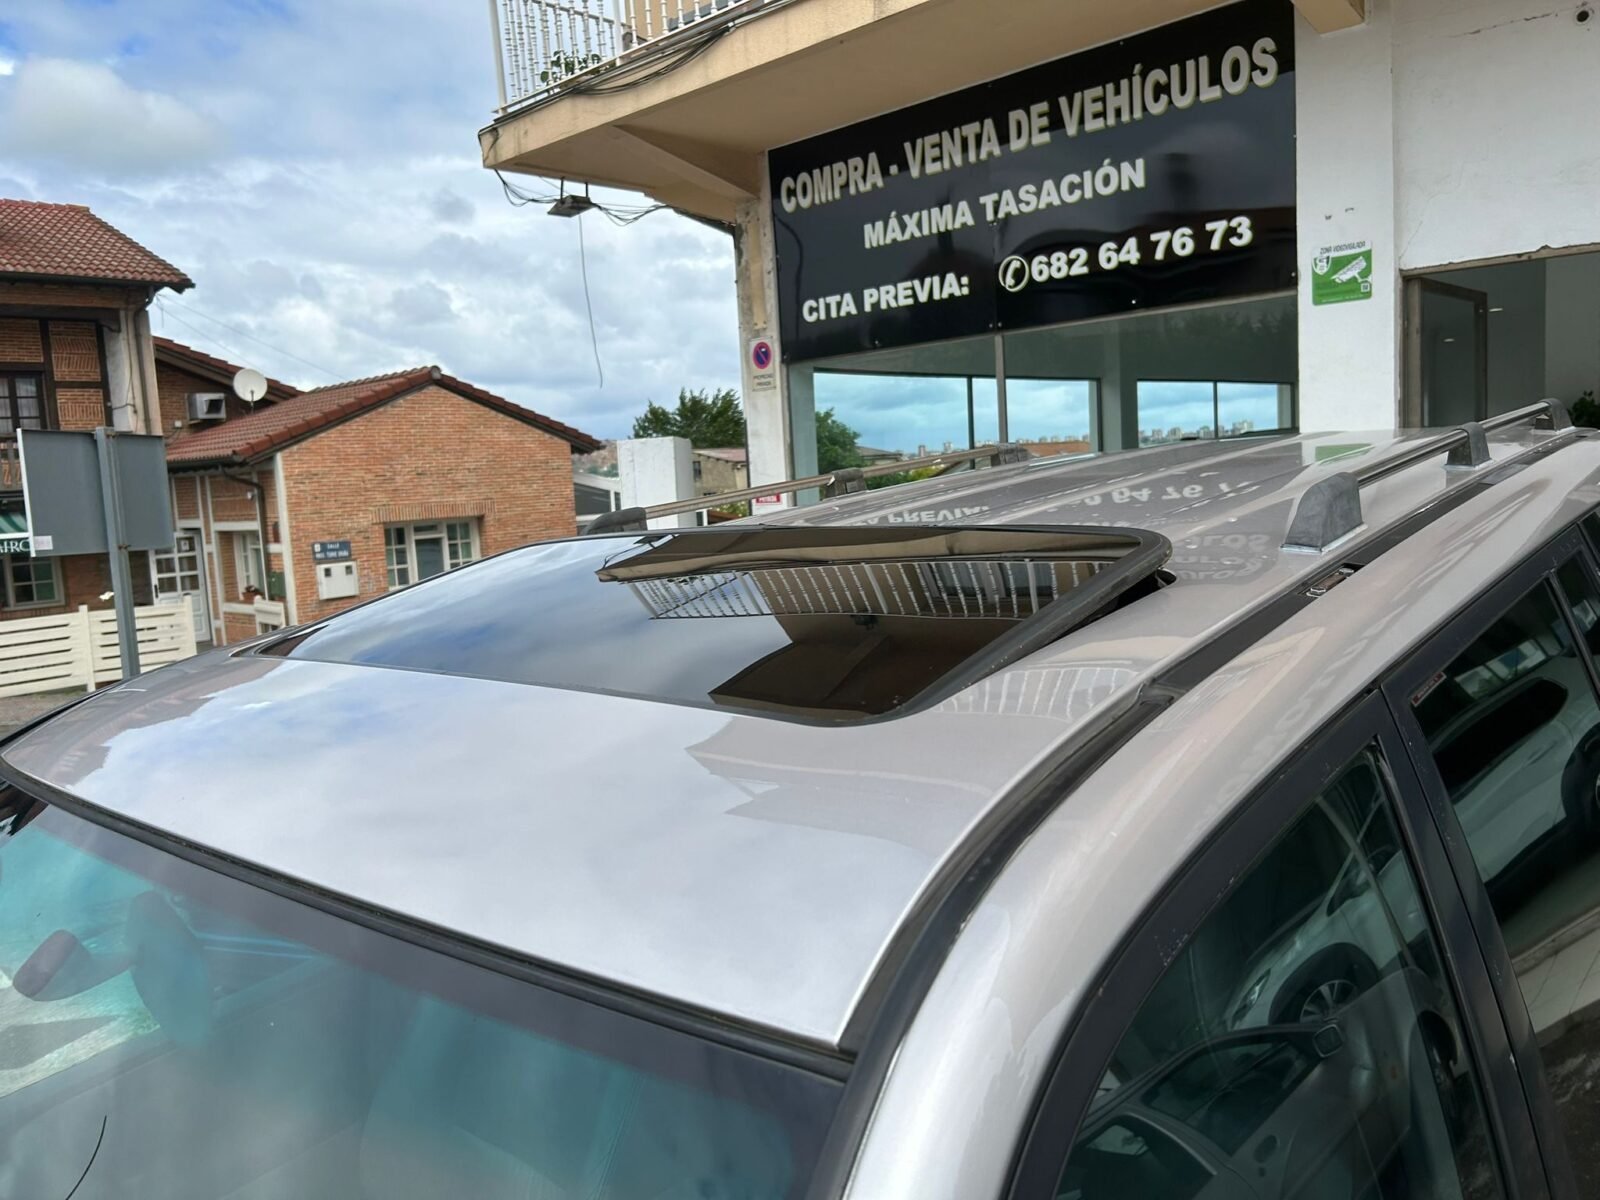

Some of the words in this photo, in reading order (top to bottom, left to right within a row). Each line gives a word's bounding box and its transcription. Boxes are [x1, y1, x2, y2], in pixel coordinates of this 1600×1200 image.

[780, 151, 884, 213] COMPRA
[903, 117, 1001, 179] VENTA
[1008, 100, 1051, 151] DE
[1058, 36, 1279, 137] VEHÍCULOS
[864, 200, 975, 249] MÁXIMA
[979, 158, 1146, 222] TASACIÓN
[802, 292, 858, 322] CITA
[863, 272, 970, 312] PREVIA:
[1031, 248, 1089, 283] 682
[1098, 237, 1141, 270] 64
[1150, 227, 1195, 261] 76
[1205, 216, 1253, 251] 73
